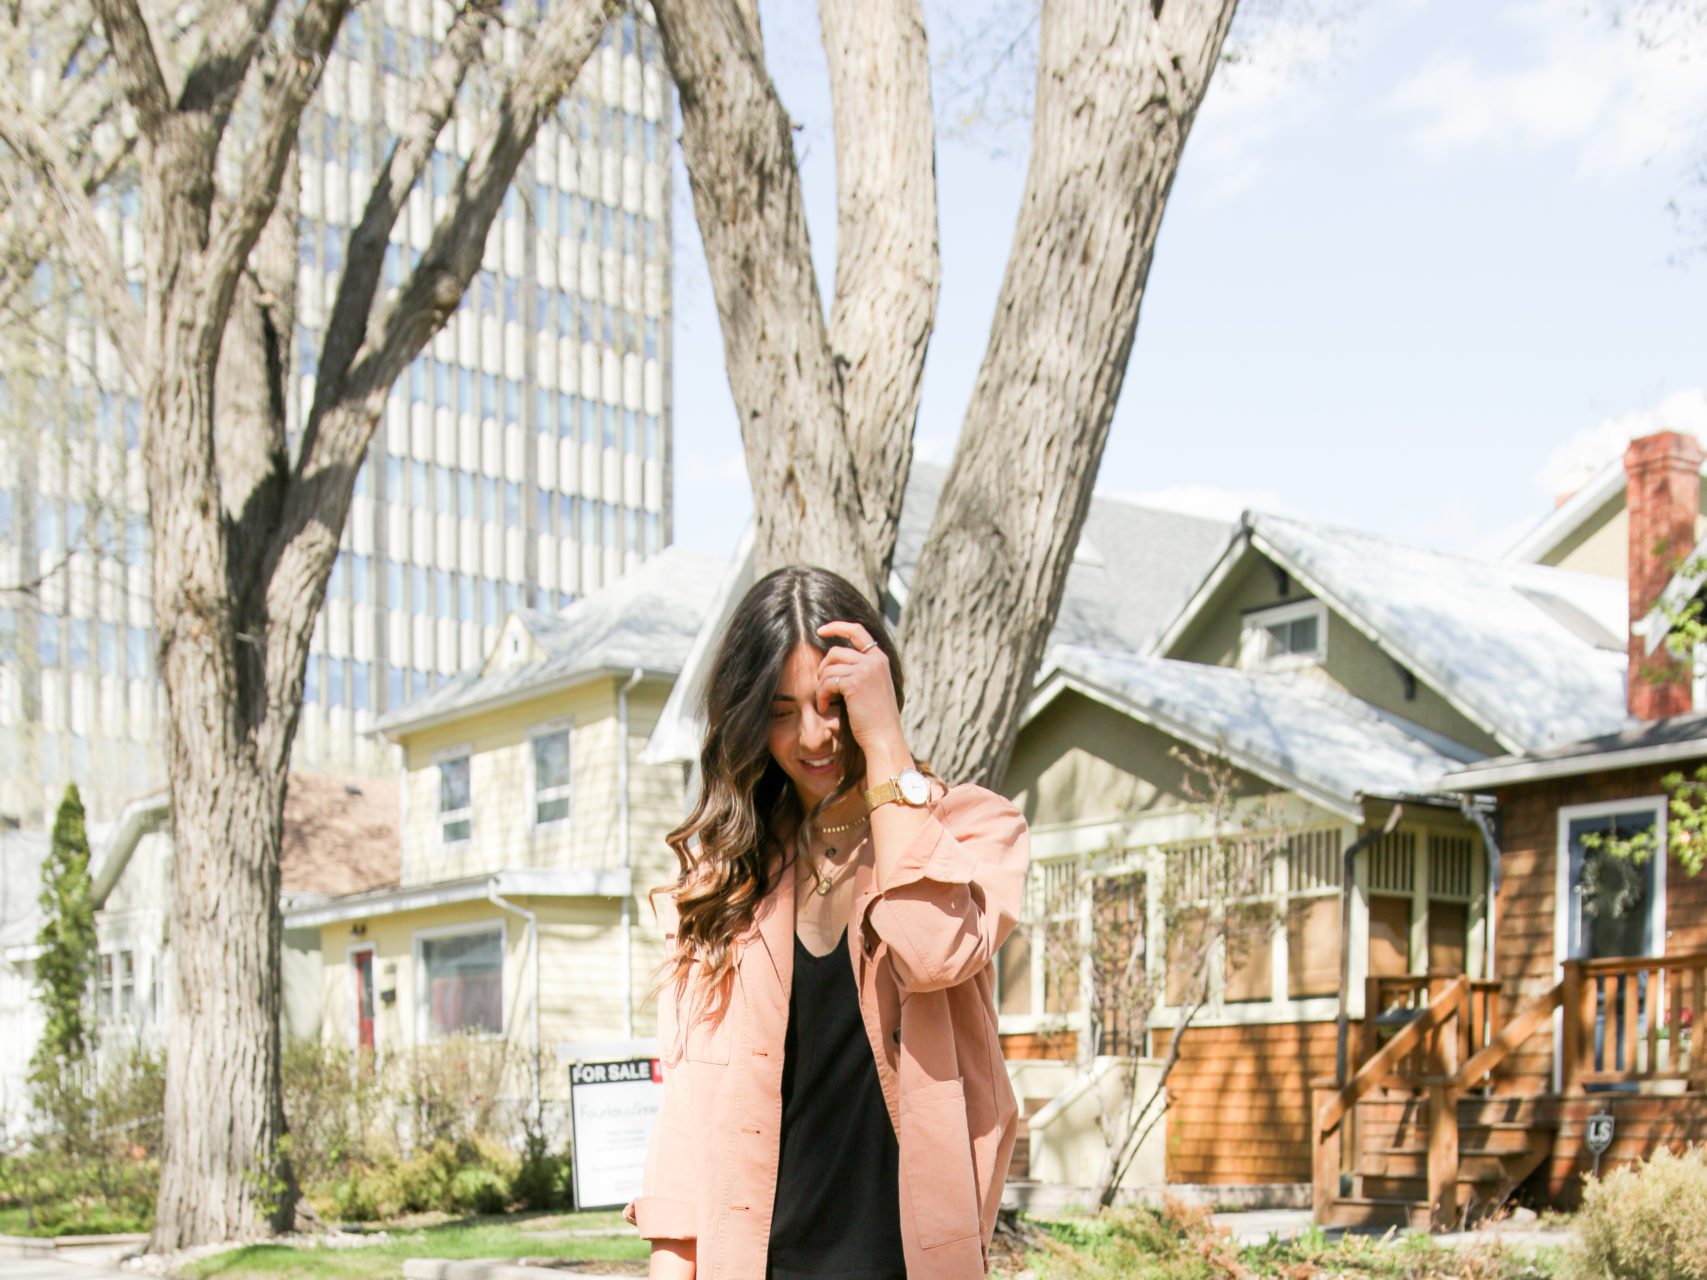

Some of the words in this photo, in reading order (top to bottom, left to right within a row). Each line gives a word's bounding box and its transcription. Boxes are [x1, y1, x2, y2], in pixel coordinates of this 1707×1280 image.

[572, 1064, 606, 1083] FOR
[608, 1062, 650, 1081] SALE
[1590, 1121, 1611, 1141] LS
